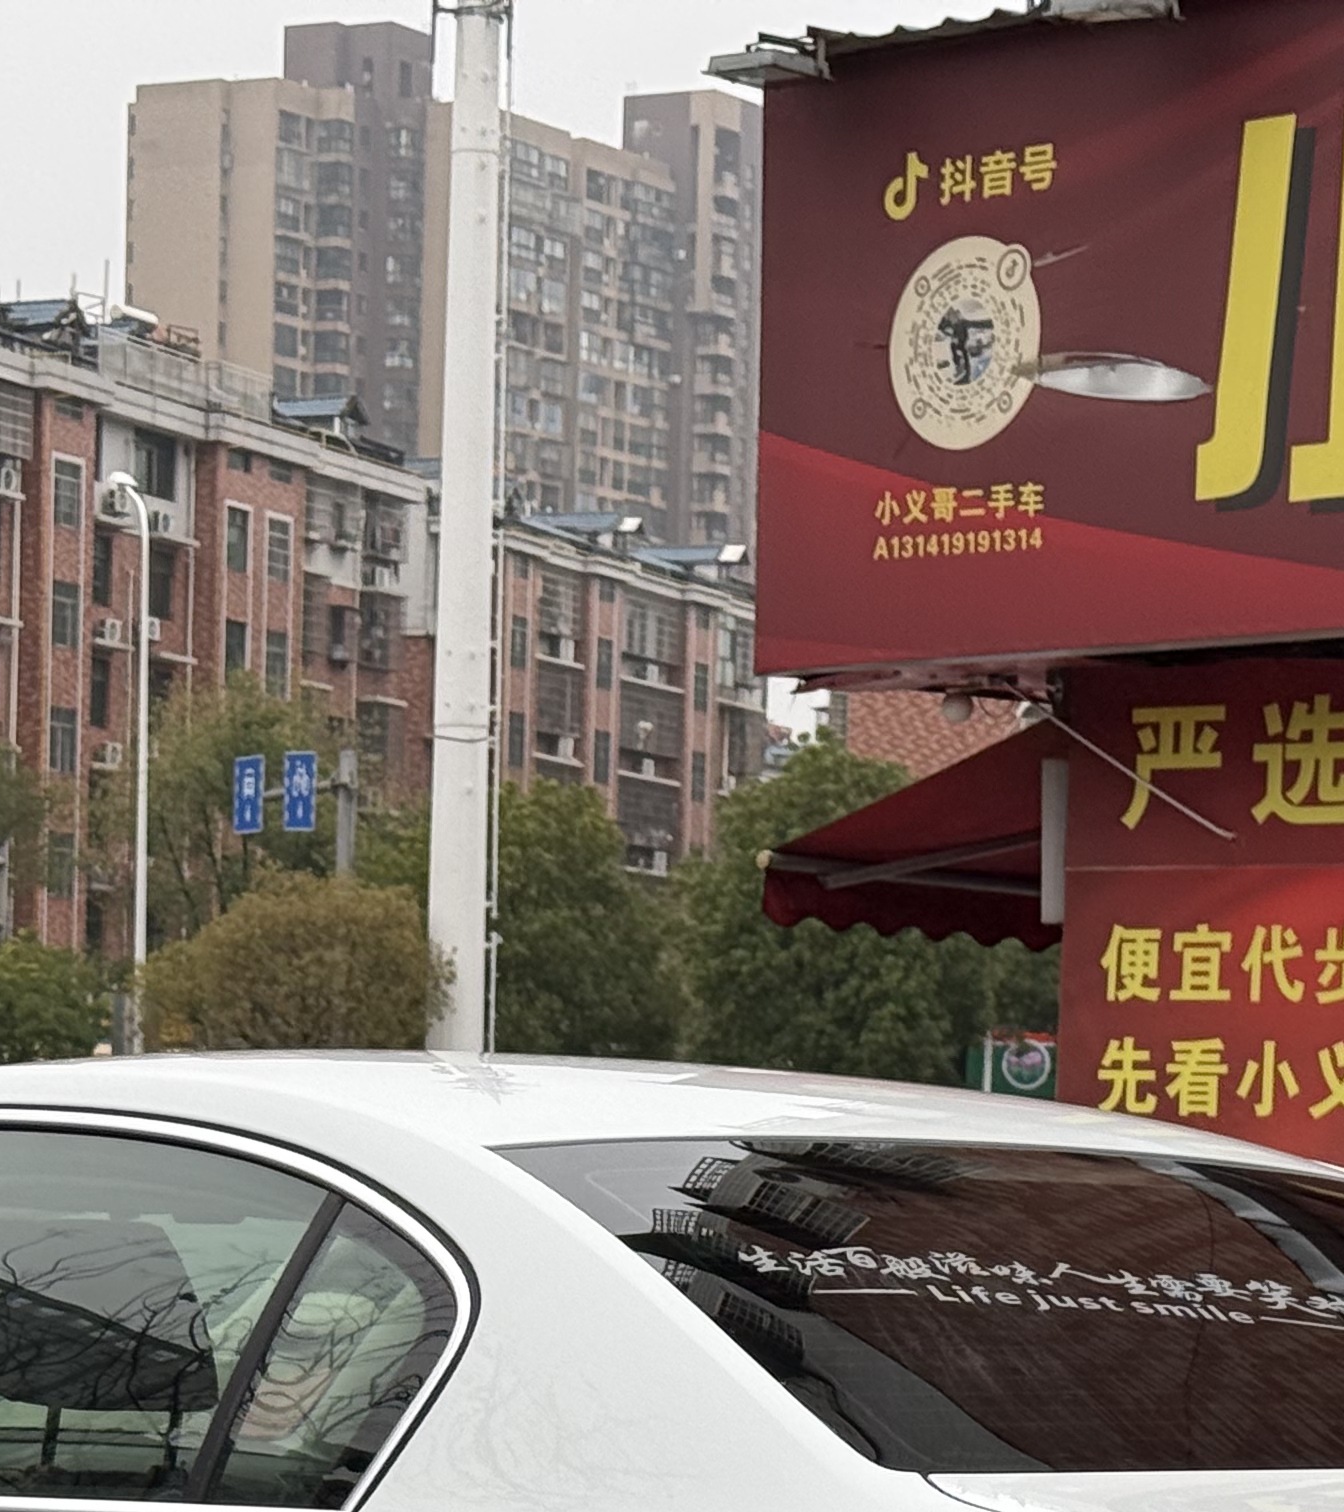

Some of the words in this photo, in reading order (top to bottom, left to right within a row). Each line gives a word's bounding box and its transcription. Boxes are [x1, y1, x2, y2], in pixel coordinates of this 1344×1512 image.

[939, 142, 1058, 207] 抖音号
[874, 480, 1045, 526] 小义哥二手车
[872, 526, 1043, 561] A131419191314
[926, 1284, 1023, 1307] Life
[1029, 1288, 1124, 1313] just
[1130, 1299, 1255, 1325] smile
